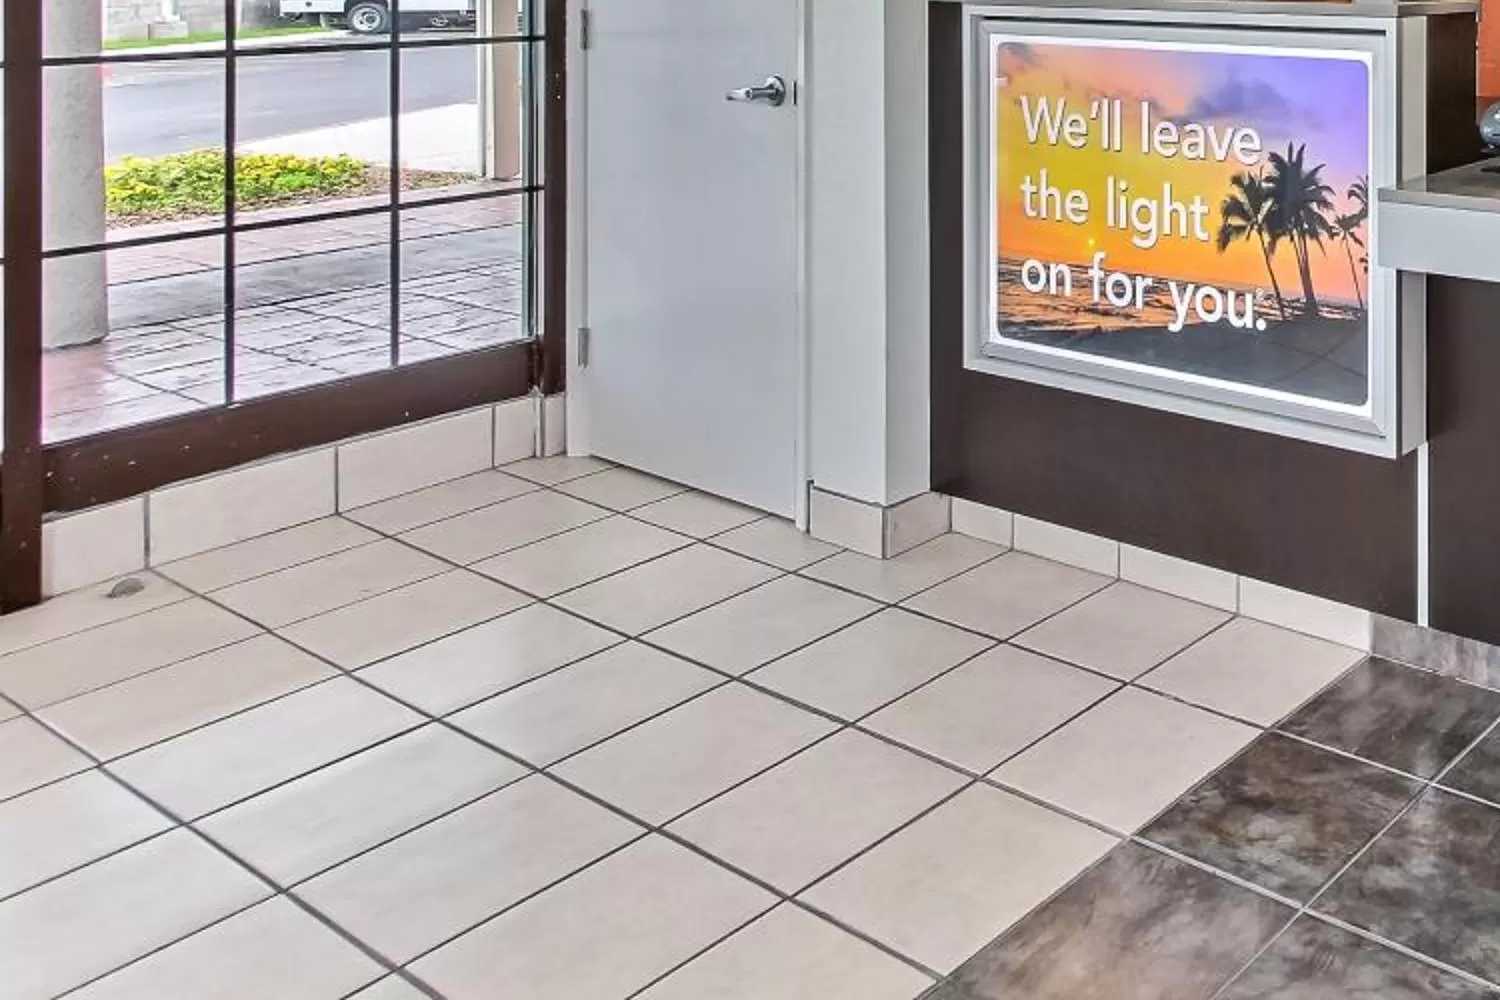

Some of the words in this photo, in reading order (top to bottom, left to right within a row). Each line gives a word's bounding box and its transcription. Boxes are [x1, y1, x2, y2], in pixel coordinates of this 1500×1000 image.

[1020, 95, 1123, 152] We'll
[1141, 101, 1262, 165] leave
[1020, 169, 1089, 224] the
[1107, 176, 1210, 249] light
[1021, 257, 1072, 297] on
[1088, 252, 1153, 310] for
[1167, 281, 1267, 332] you.
